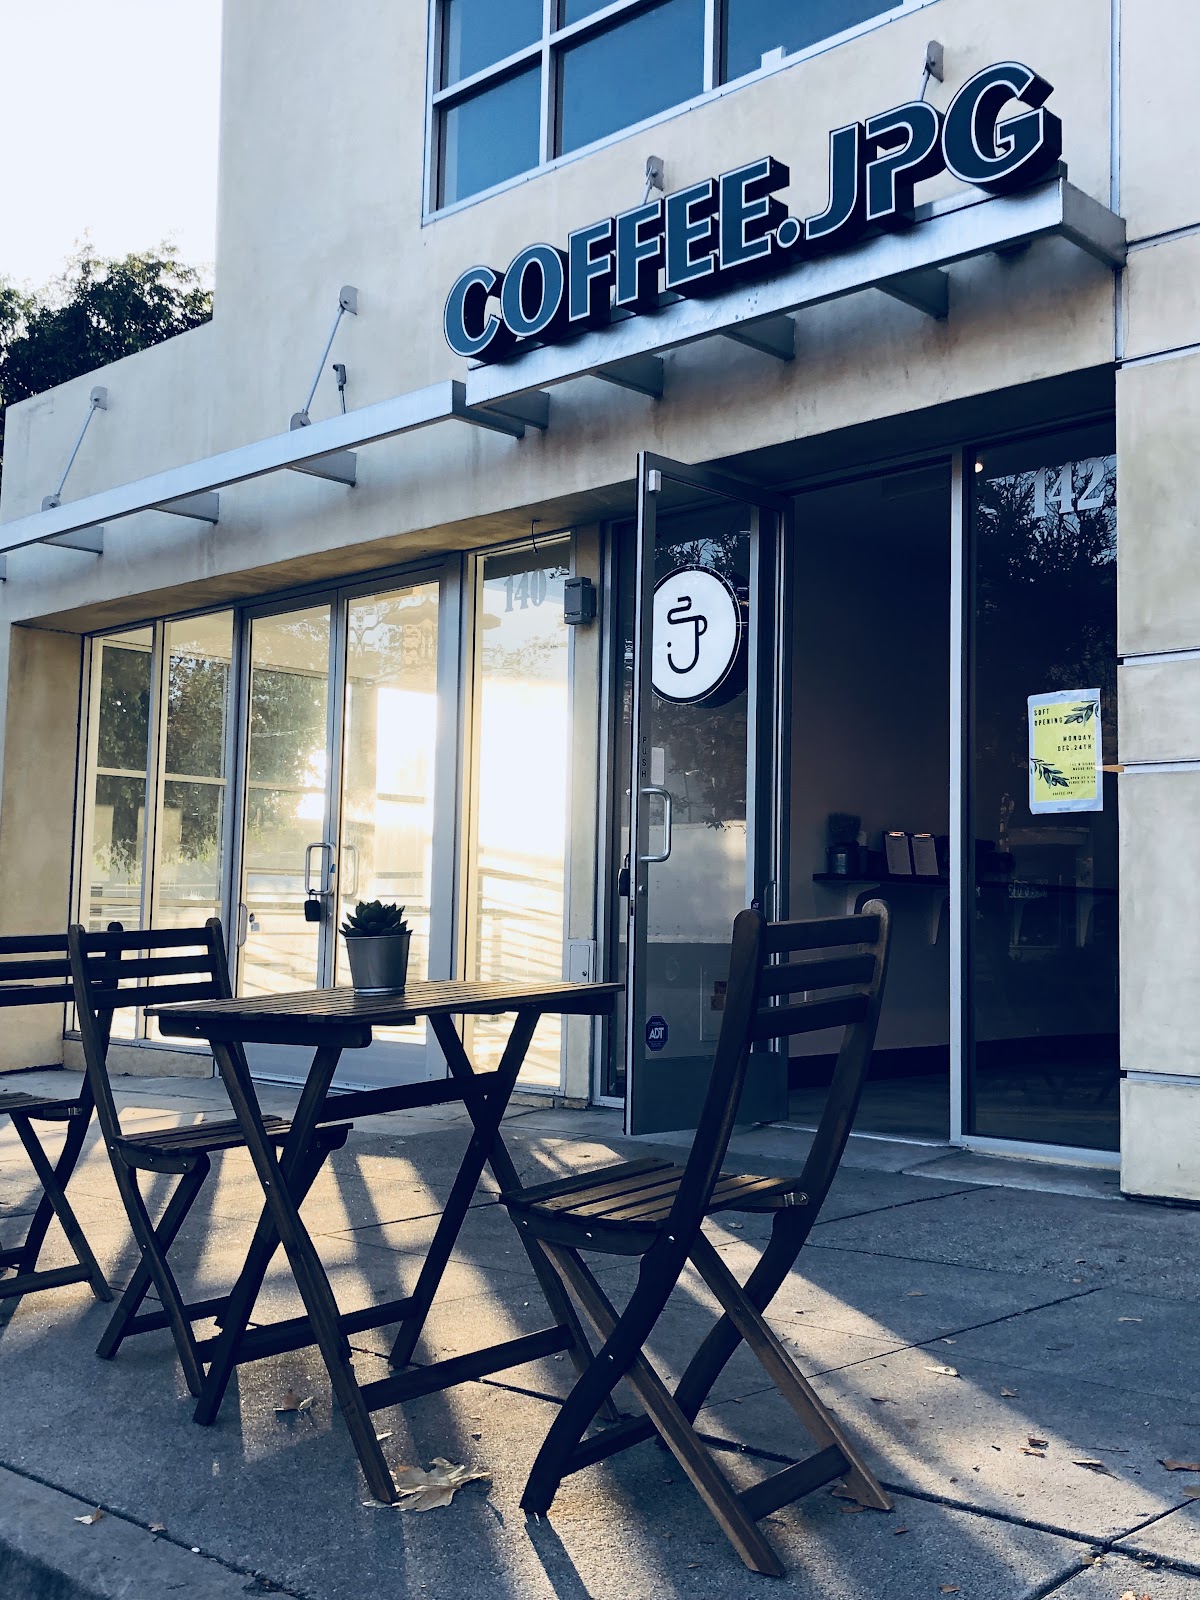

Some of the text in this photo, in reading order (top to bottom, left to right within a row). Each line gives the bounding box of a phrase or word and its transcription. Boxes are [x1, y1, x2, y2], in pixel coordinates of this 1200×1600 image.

[443, 61, 1046, 358] COFFEE.JPG
[1030, 457, 1105, 519] 142
[504, 568, 547, 612] 140
[1034, 708, 1049, 716] SOFT
[1034, 716, 1063, 726] OPENING
[649, 1027, 664, 1039] ADT
